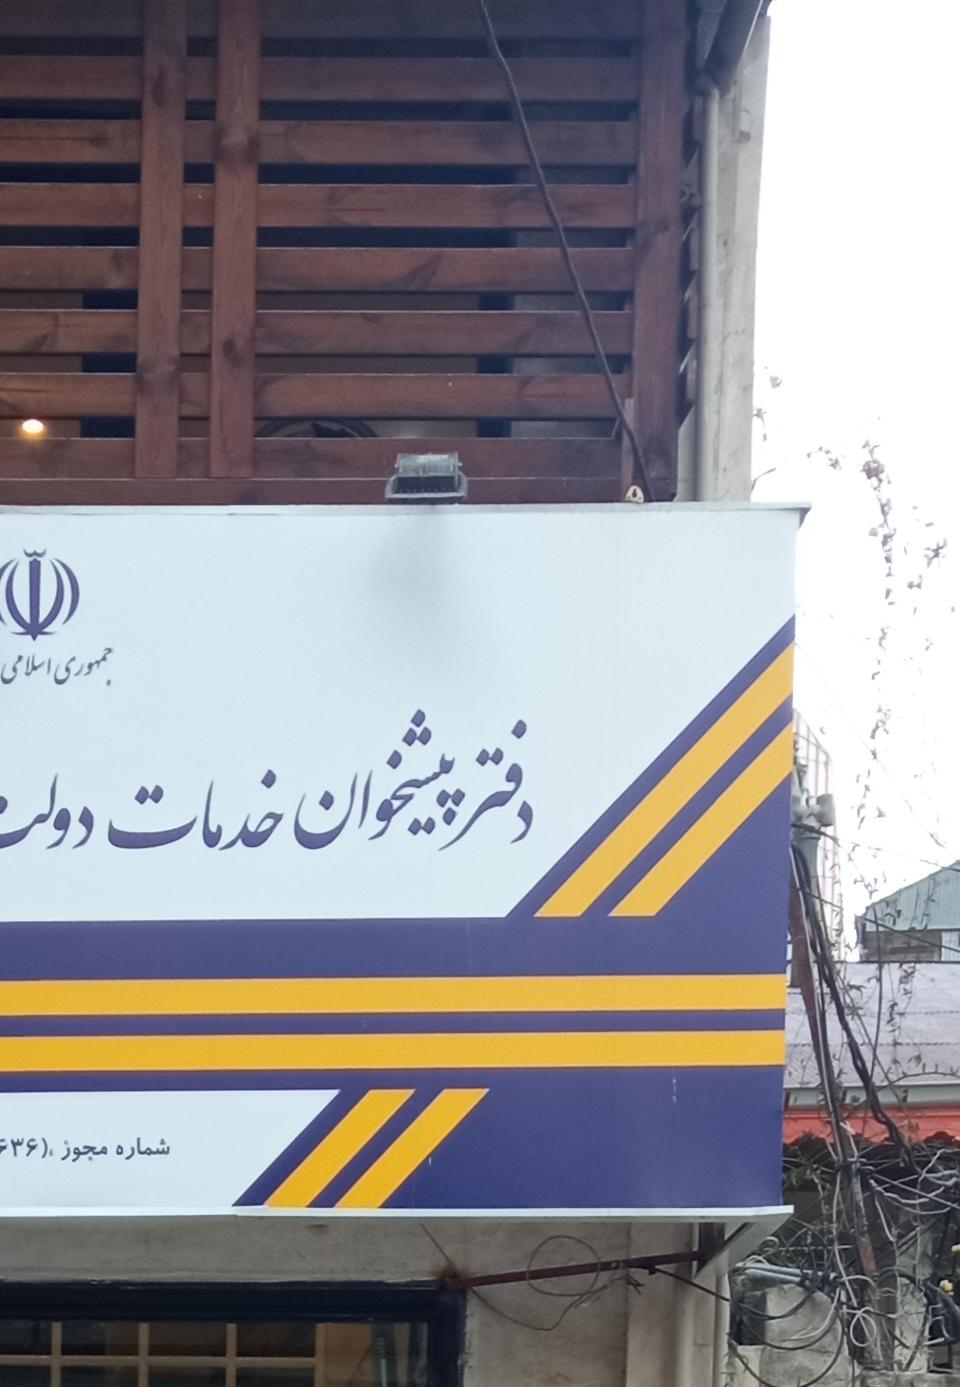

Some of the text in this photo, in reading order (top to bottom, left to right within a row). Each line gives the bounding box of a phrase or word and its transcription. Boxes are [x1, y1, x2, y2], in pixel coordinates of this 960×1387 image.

[1, 654, 51, 685] اسلامی
[54, 648, 113, 687] جمهوری
[294, 709, 466, 850] پیشخوان
[440, 719, 533, 850] دفتر
[107, 769, 284, 851] خدمات
[61, 1141, 108, 1163] مجوز
[115, 1137, 170, 1160] شماره
